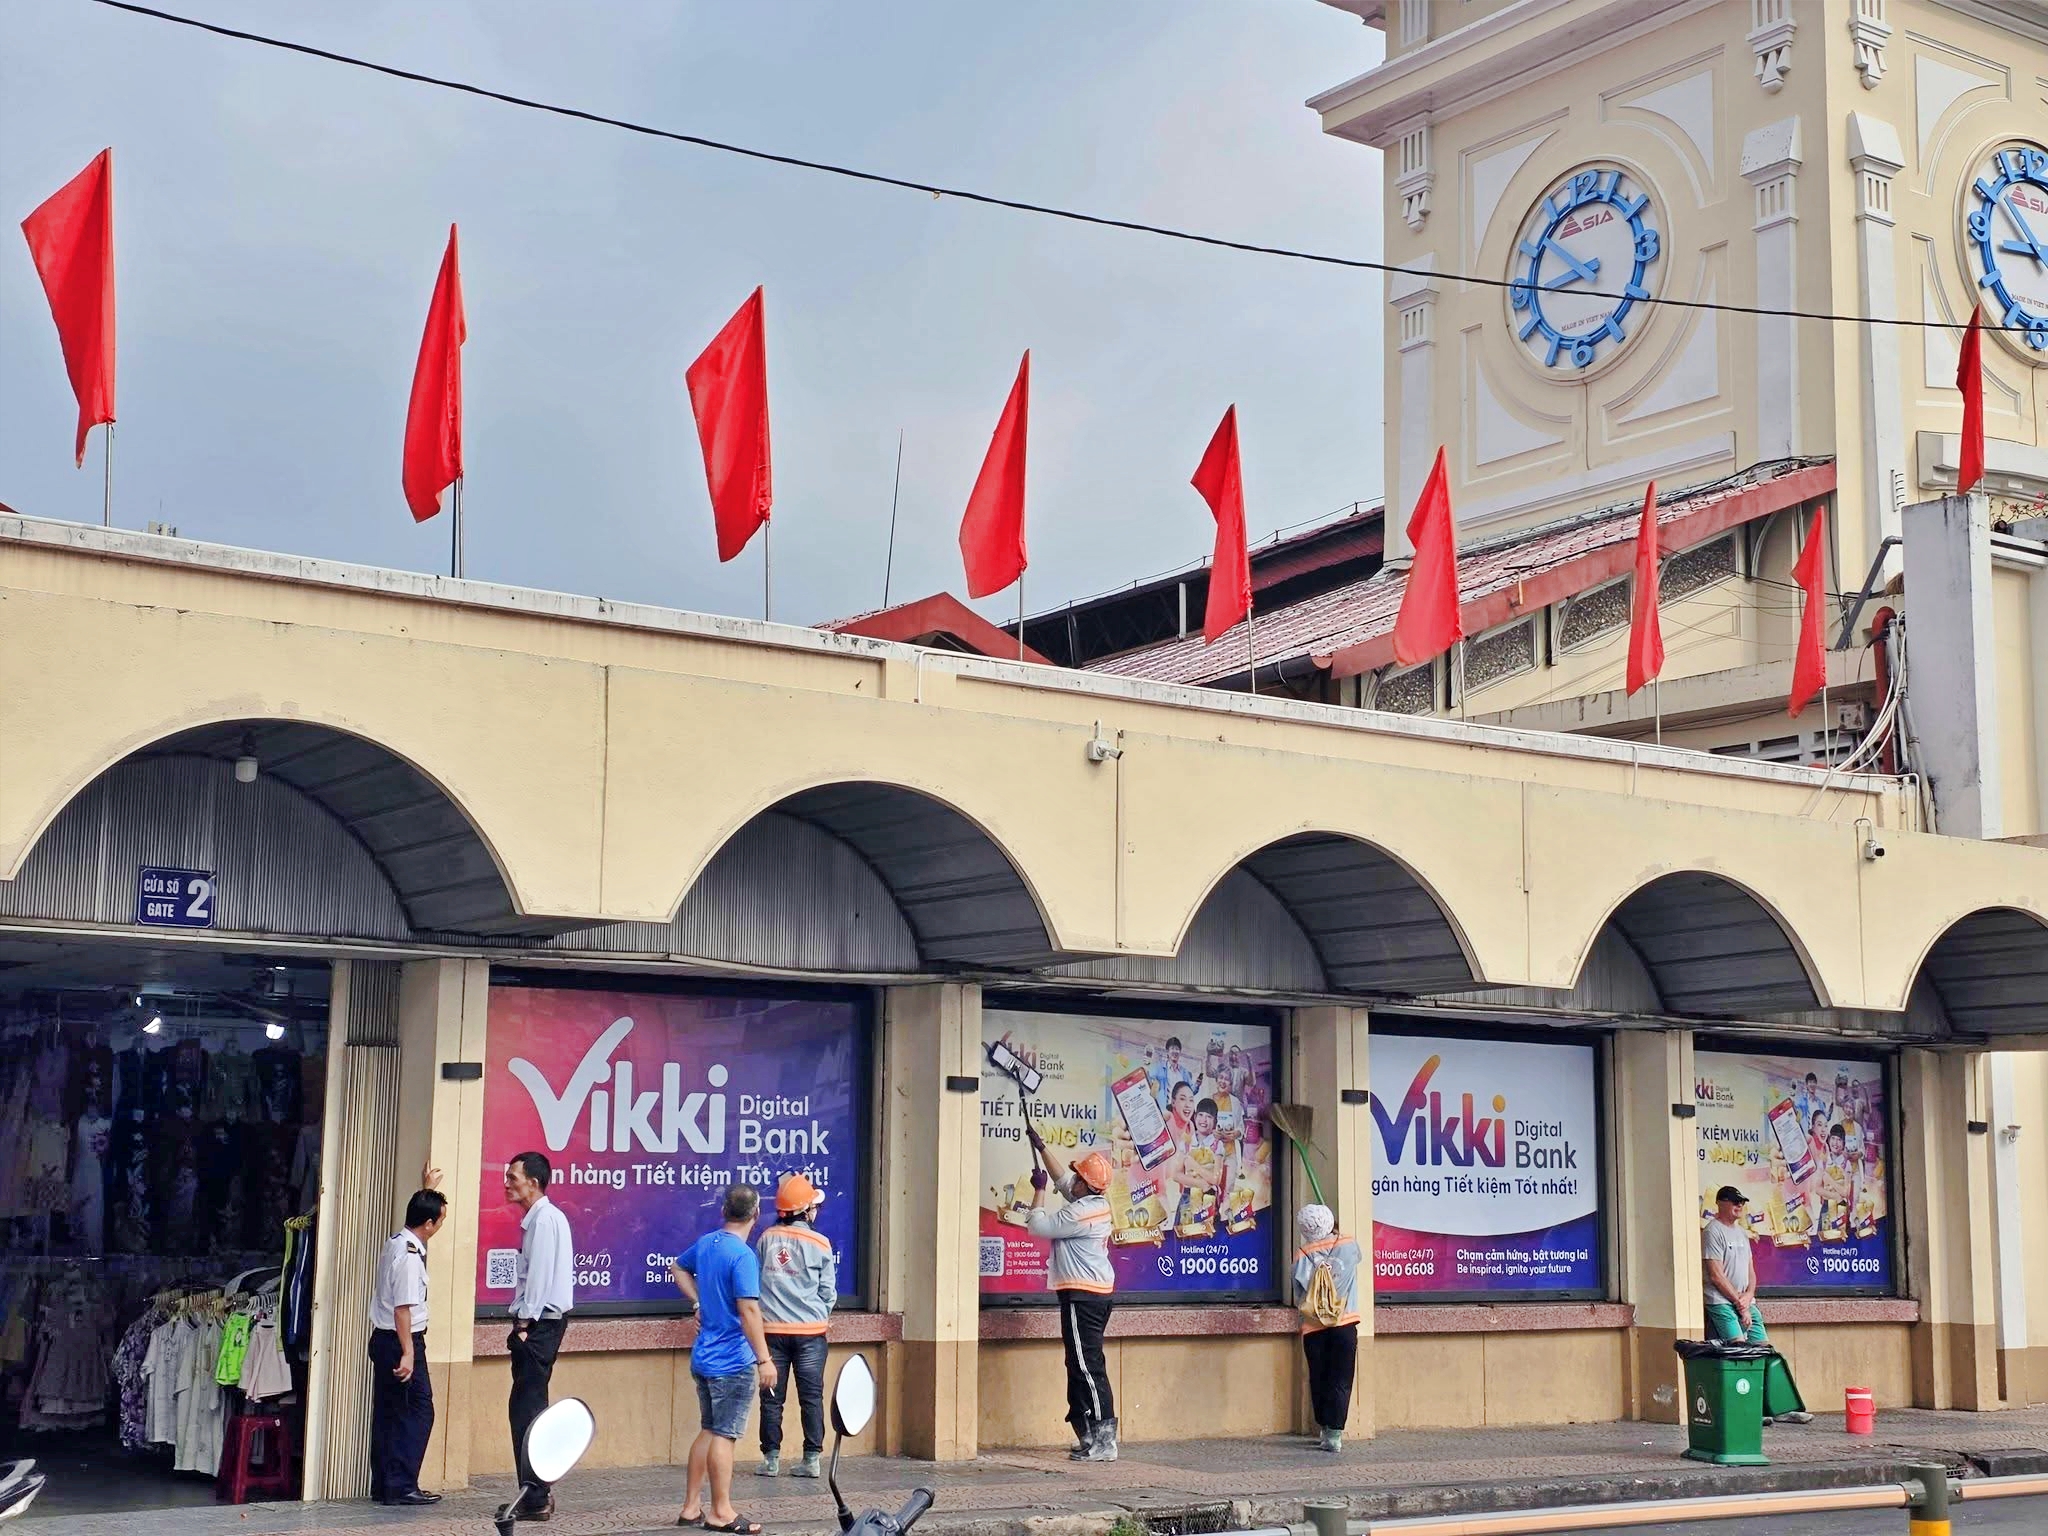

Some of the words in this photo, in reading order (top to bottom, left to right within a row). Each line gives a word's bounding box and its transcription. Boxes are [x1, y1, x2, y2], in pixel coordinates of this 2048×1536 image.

[1567, 169, 1598, 207] 12
[2010, 185, 2048, 215] ASI
[1559, 210, 1615, 240] ASIA
[1968, 210, 1991, 242] 9
[1635, 229, 1660, 262] 3
[1510, 278, 1529, 310] 9
[1571, 337, 1594, 368] 6
[143, 874, 164, 893] CỬA
[166, 877, 181, 894] SỐ
[147, 903, 175, 918] GATE
[186, 879, 210, 919] 2
[1039, 1059, 1065, 1071] Bank
[507, 1016, 729, 1154] Vikki
[1694, 1077, 1714, 1101] kki
[1715, 1091, 1735, 1102] Bank
[739, 1094, 809, 1121] Digital
[981, 1094, 1014, 1117] TIẾT
[1060, 1103, 1097, 1120] Vikki
[1370, 1054, 1506, 1168] Vikki
[738, 1119, 830, 1156] Bank
[980, 1122, 1021, 1142] Trúng
[1034, 1122, 1078, 1149] ÀNG
[1080, 1128, 1097, 1147] ký
[1515, 1119, 1562, 1141] Digital
[1702, 1124, 1730, 1145] KIỆM
[1732, 1128, 1759, 1143] Vikki
[1515, 1140, 1578, 1170] Bank
[1747, 1148, 1759, 1165] ký
[570, 1163, 626, 1190] hàng
[631, 1161, 676, 1186] Tiết
[681, 1165, 731, 1191] kiệm
[737, 1162, 771, 1186] Tốt
[1371, 1175, 1399, 1196] gân
[1403, 1175, 1440, 1196] hàng
[1444, 1173, 1474, 1194] Tiết
[1477, 1176, 1511, 1199] kiệm
[1514, 1174, 1538, 1195] Tốt
[1541, 1174, 1578, 1195] nhất!
[1125, 1207, 1150, 1228] 10
[573, 1253, 611, 1268] (24/7)
[1180, 1245, 1205, 1254] Hotline
[1205, 1245, 1229, 1256] (24/7)
[1381, 1250, 1408, 1260] Hotline
[1408, 1248, 1434, 1261] (24/7)
[1456, 1248, 1484, 1263] Chạm
[1485, 1248, 1505, 1261] cảm
[1506, 1248, 1532, 1263] hứng,
[1533, 1249, 1549, 1264] bật
[1550, 1249, 1576, 1263] tương
[1576, 1248, 1588, 1260] lai
[646, 1271, 662, 1283] Be
[1180, 1258, 1217, 1275] 1900
[1219, 1258, 1259, 1275] 6608
[1375, 1263, 1403, 1277] 1900
[1404, 1262, 1435, 1276] 6608
[1457, 1263, 1468, 1274] Be
[1469, 1263, 1505, 1277] inspired,
[1505, 1263, 1528, 1276] ignite
[1529, 1266, 1547, 1277] your
[1548, 1262, 1572, 1274] future
[1822, 1258, 1850, 1273] 1900
[1851, 1258, 1880, 1273] 6608
